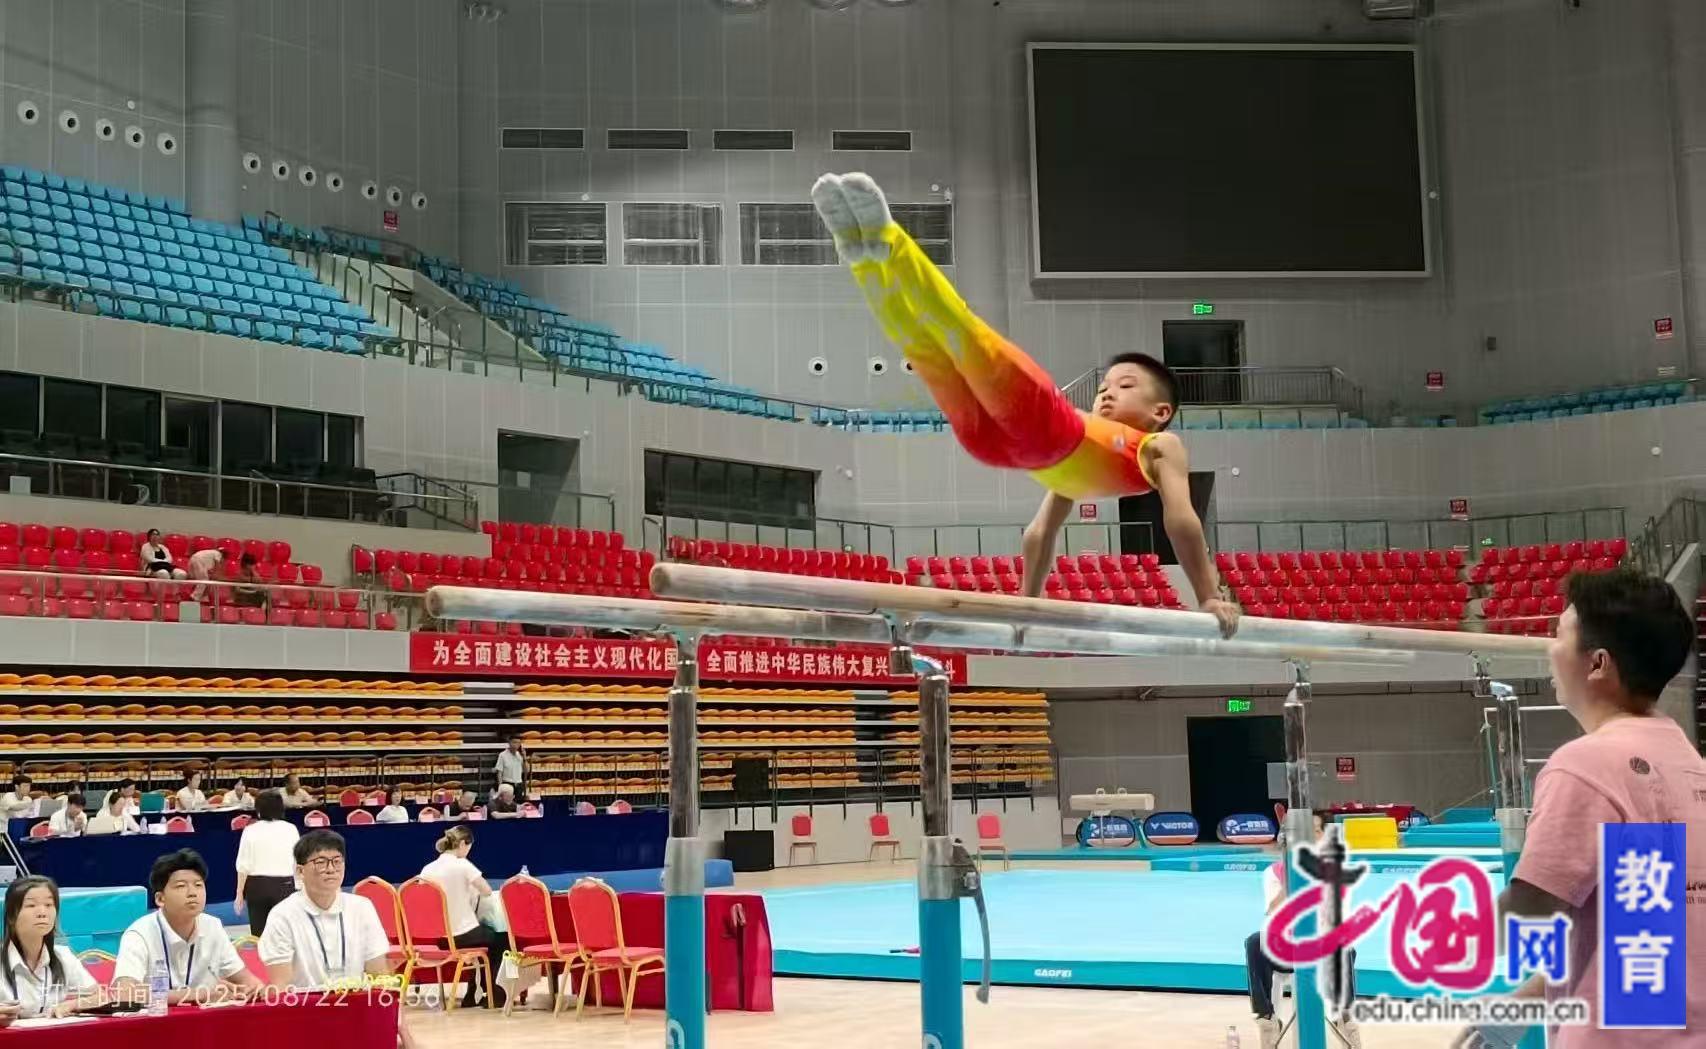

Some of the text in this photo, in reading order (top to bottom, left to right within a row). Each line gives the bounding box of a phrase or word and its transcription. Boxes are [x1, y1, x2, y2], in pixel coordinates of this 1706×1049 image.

[433, 638, 956, 680] 为全面建设社会主义现代化国 全面推进中华民族伟大复兴斗
